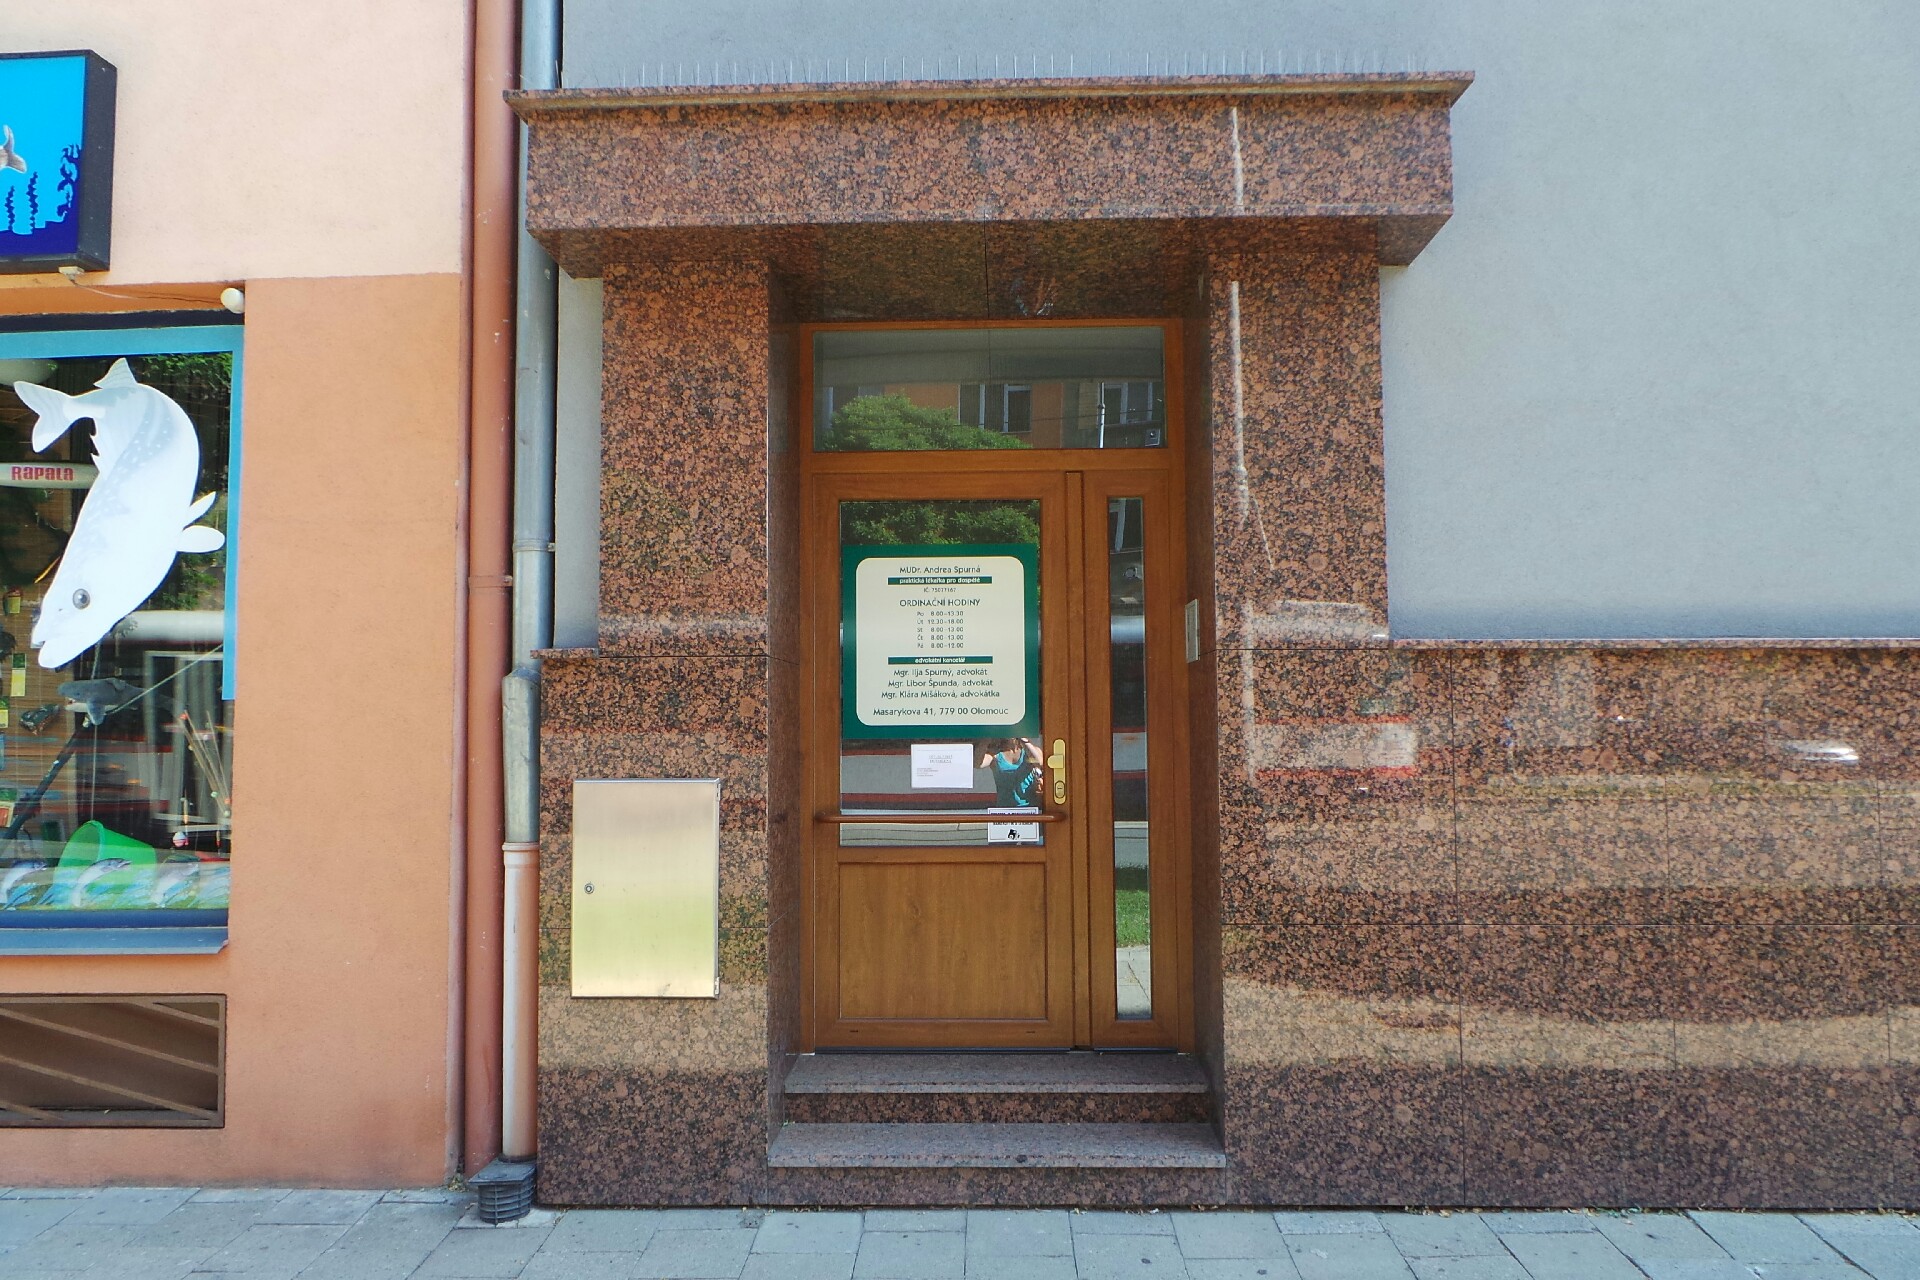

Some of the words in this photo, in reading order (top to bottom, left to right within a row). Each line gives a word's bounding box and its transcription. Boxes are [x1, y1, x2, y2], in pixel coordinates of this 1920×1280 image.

[899, 566, 922, 574] MUDr.
[924, 566, 952, 574] Andrea
[954, 565, 981, 575] Spurná
[957, 576, 981, 584] dospělé
[899, 597, 946, 607] ORDINAČNÍ
[947, 598, 981, 606] HODINY
[893, 669, 909, 678] Mgr.
[912, 668, 923, 677] Ilja
[925, 668, 954, 678] Spurný,
[956, 668, 988, 676] advokát
[888, 680, 904, 688] Mgr.
[906, 679, 926, 687] Libor
[928, 677, 960, 688] Špunda,
[962, 679, 993, 687] advokát
[881, 691, 897, 699] Mgr.
[899, 690, 919, 698] Klára
[920, 689, 958, 699] Mišáková,
[960, 690, 1000, 698] advokátka
[873, 707, 921, 717] Masarykova
[923, 708, 936, 717] 41,
[939, 708, 955, 716] 779
[957, 707, 968, 715] 00
[970, 707, 1009, 716] Olomouc
